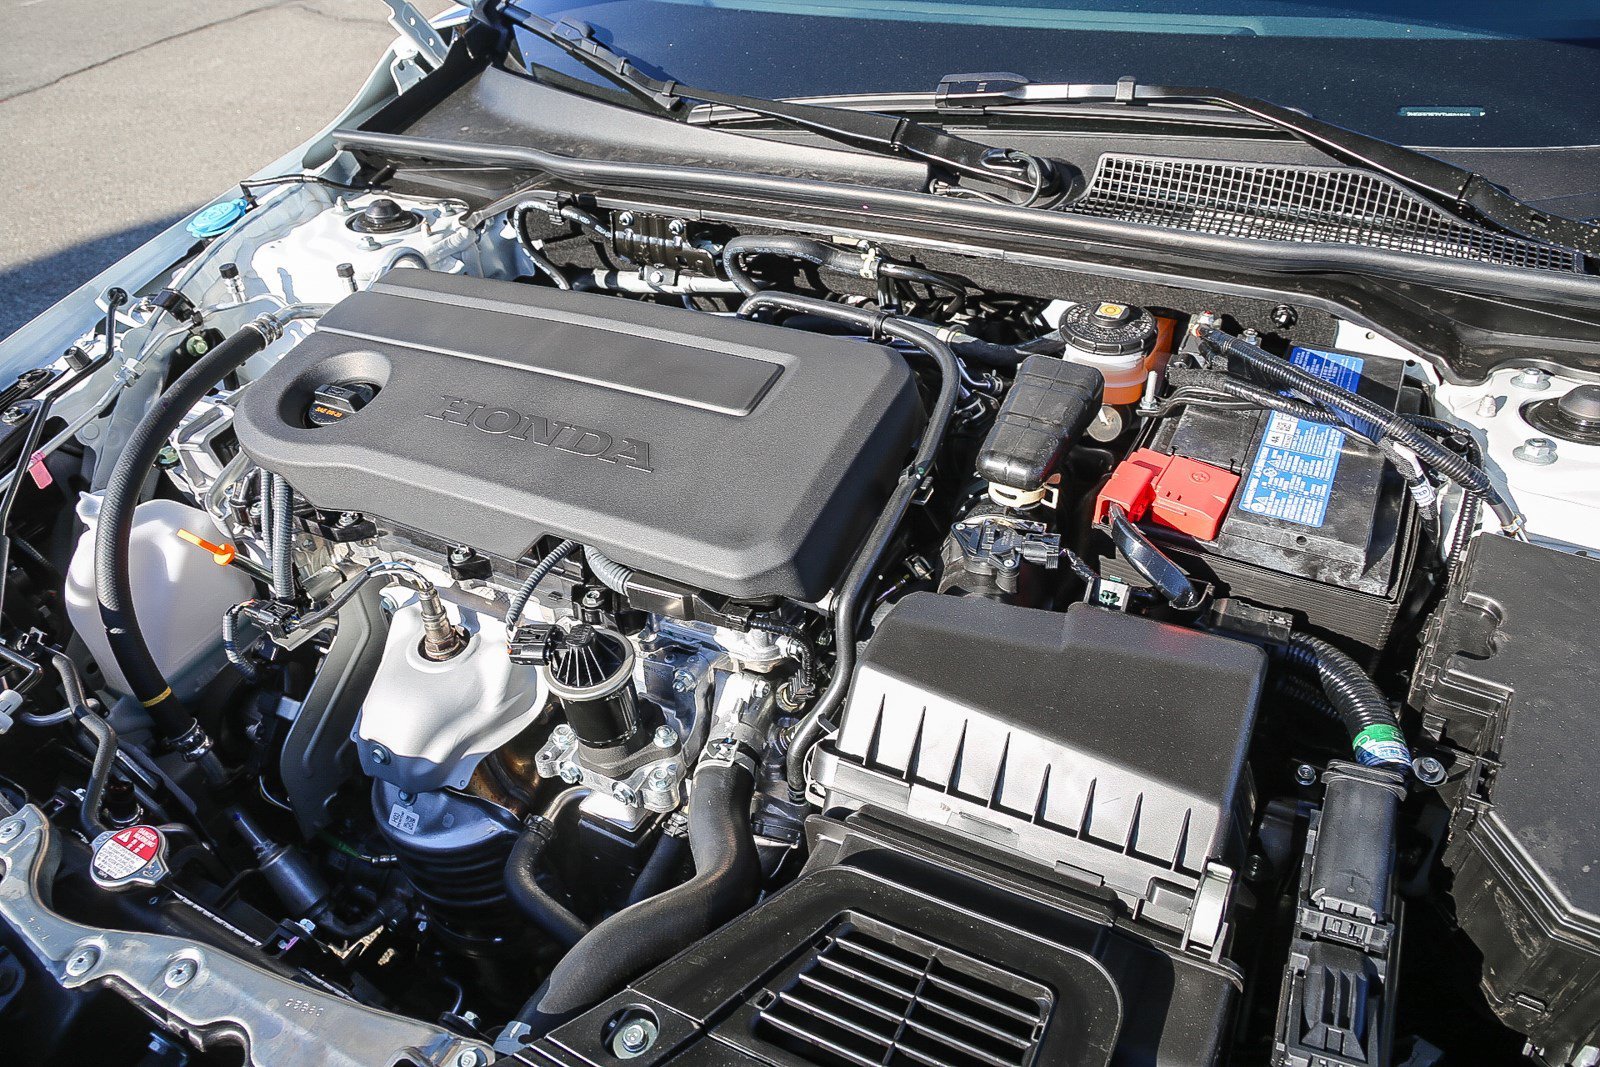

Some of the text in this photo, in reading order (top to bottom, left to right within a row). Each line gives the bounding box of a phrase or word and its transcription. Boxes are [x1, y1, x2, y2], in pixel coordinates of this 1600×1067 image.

[424, 395, 655, 474] HONDA
[132, 833, 156, 848] WARNING
[138, 828, 158, 841] DANGER
